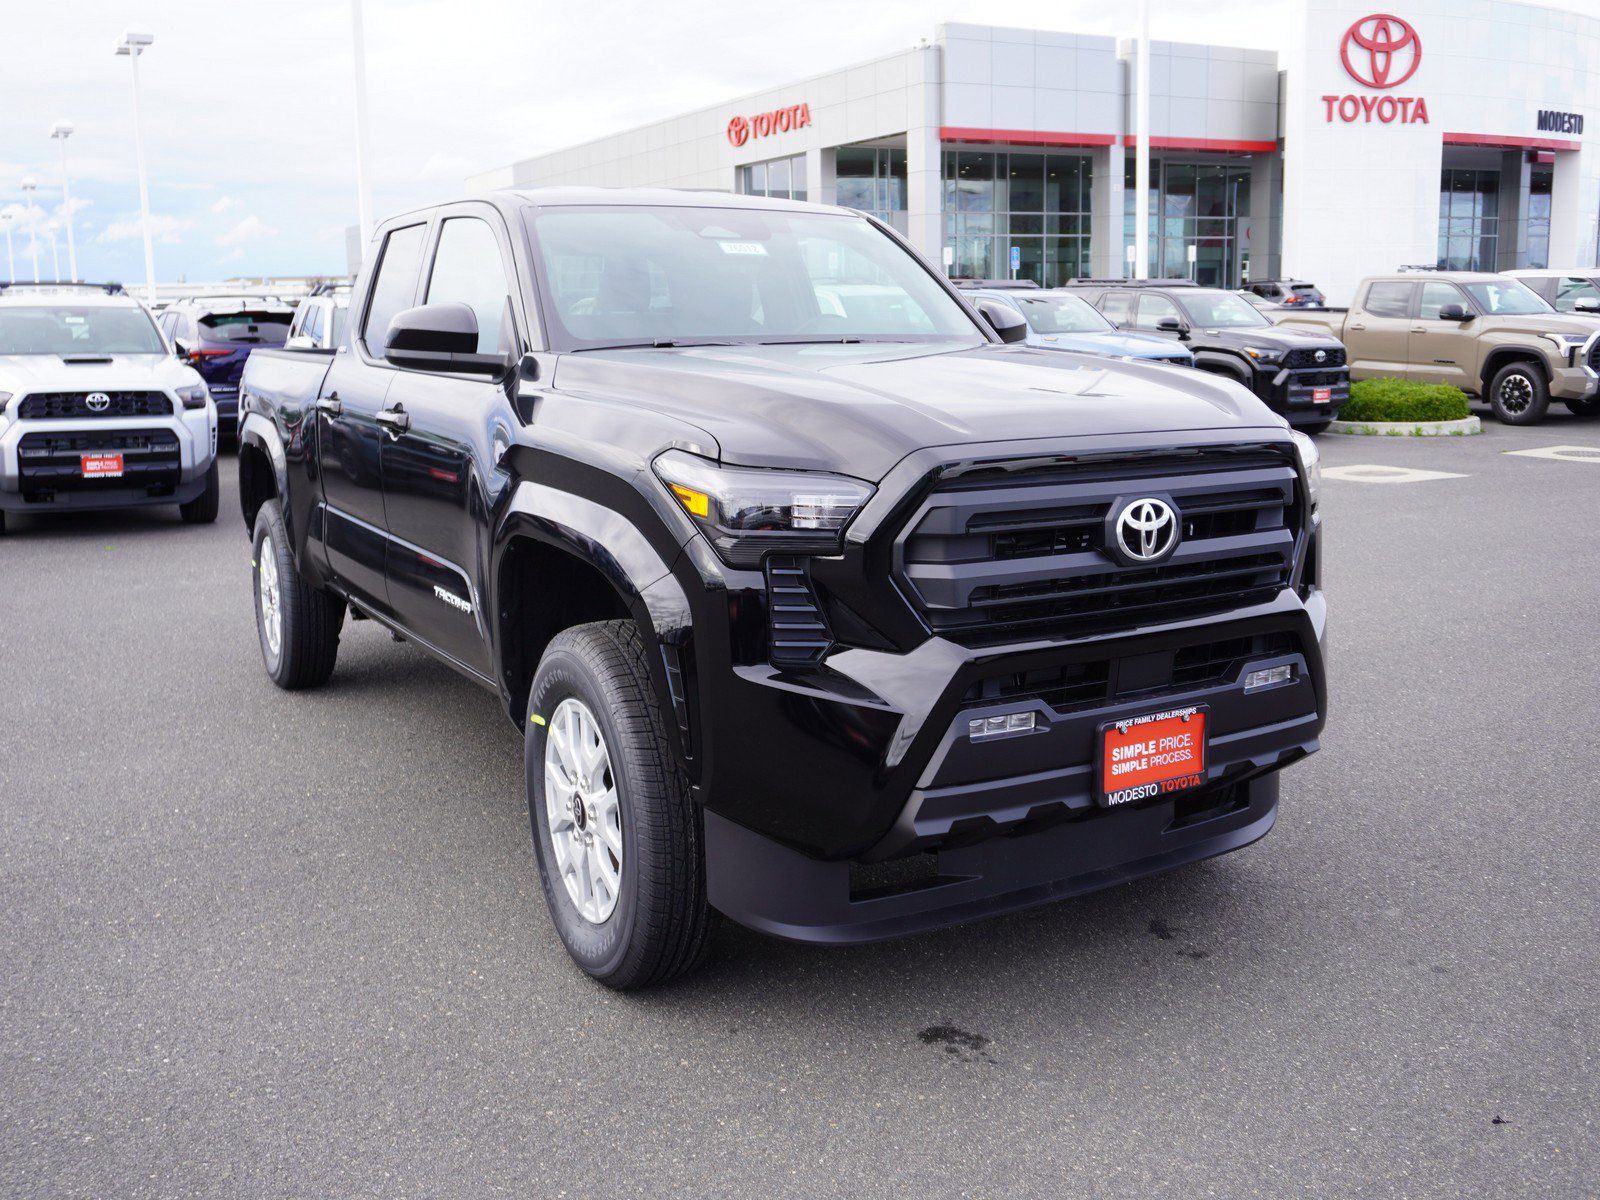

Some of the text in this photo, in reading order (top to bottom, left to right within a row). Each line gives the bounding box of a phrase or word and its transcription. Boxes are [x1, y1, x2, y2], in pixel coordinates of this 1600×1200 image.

[750, 102, 811, 139] TOYOTA
[1322, 94, 1430, 124] TOYOTA
[1537, 110, 1584, 135] MODESTO
[433, 585, 471, 614] TACOMA
[1115, 707, 1197, 729] PRICE FAMILY DEALERSHIPS
[1111, 733, 1194, 762] SIMPLE PRICE.
[1111, 749, 1194, 775] SIMPLE PROCESS.
[1108, 774, 1201, 806] MODESTO TOYOTA
